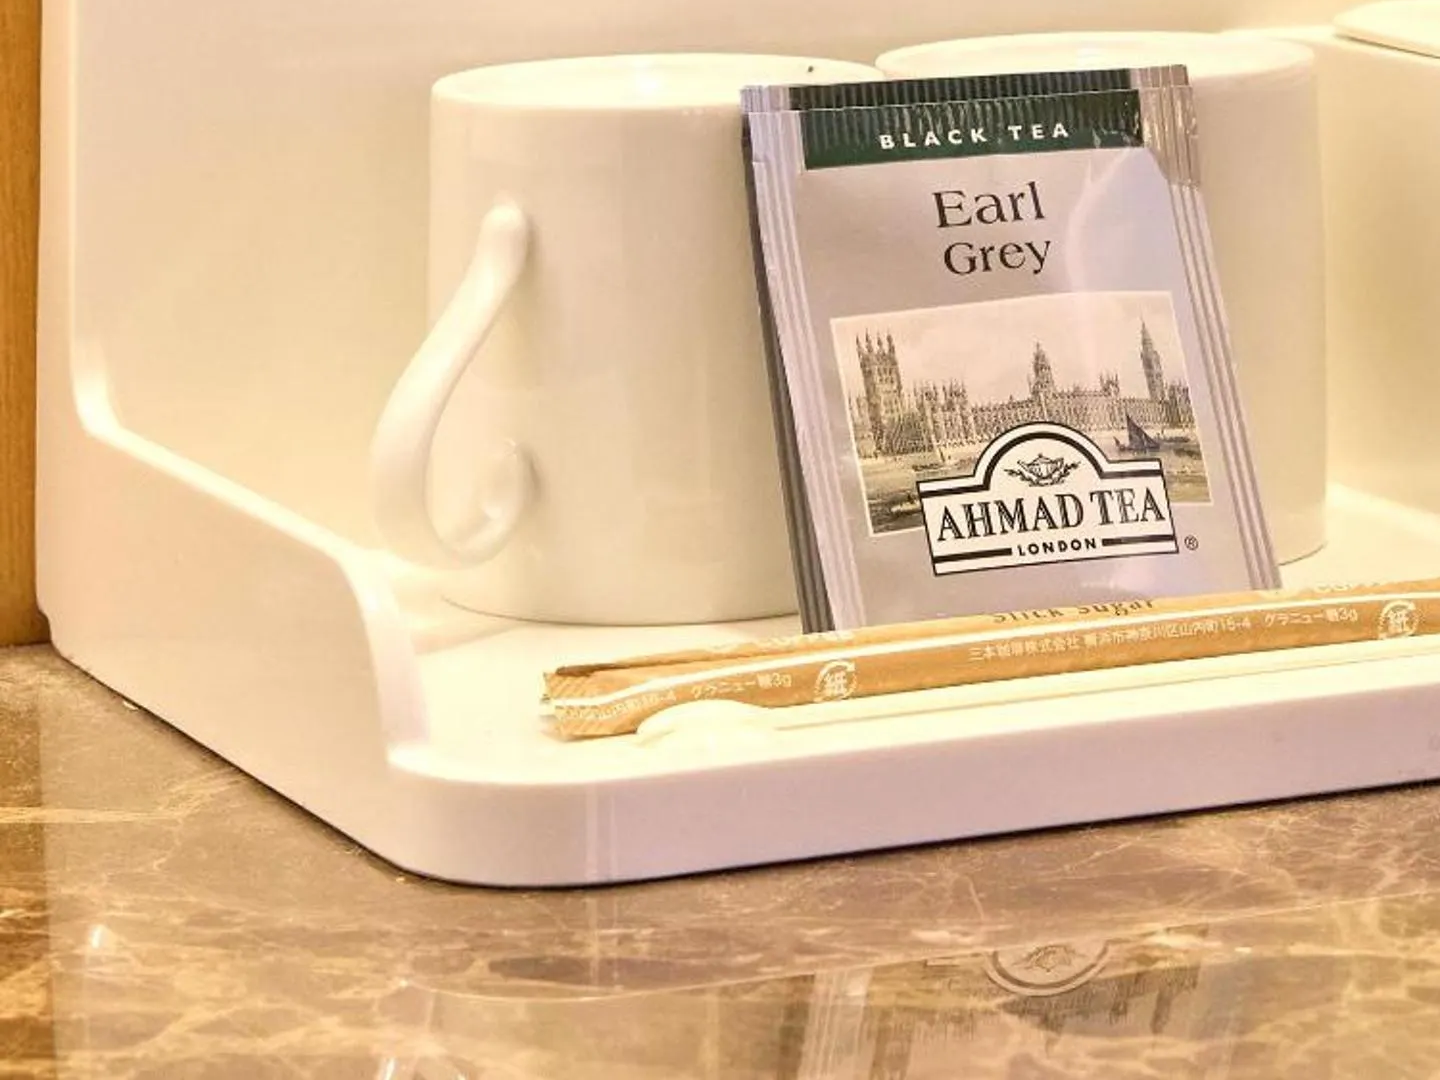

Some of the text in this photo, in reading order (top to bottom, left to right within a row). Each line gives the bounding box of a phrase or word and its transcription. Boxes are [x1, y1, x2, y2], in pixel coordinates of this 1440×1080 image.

[878, 122, 1069, 150] BLACK TEA
[932, 181, 1045, 228] Earl
[944, 240, 1051, 275] Grey
[937, 486, 1167, 542] AHMAD TEA
[1017, 537, 1098, 557] LONDON
